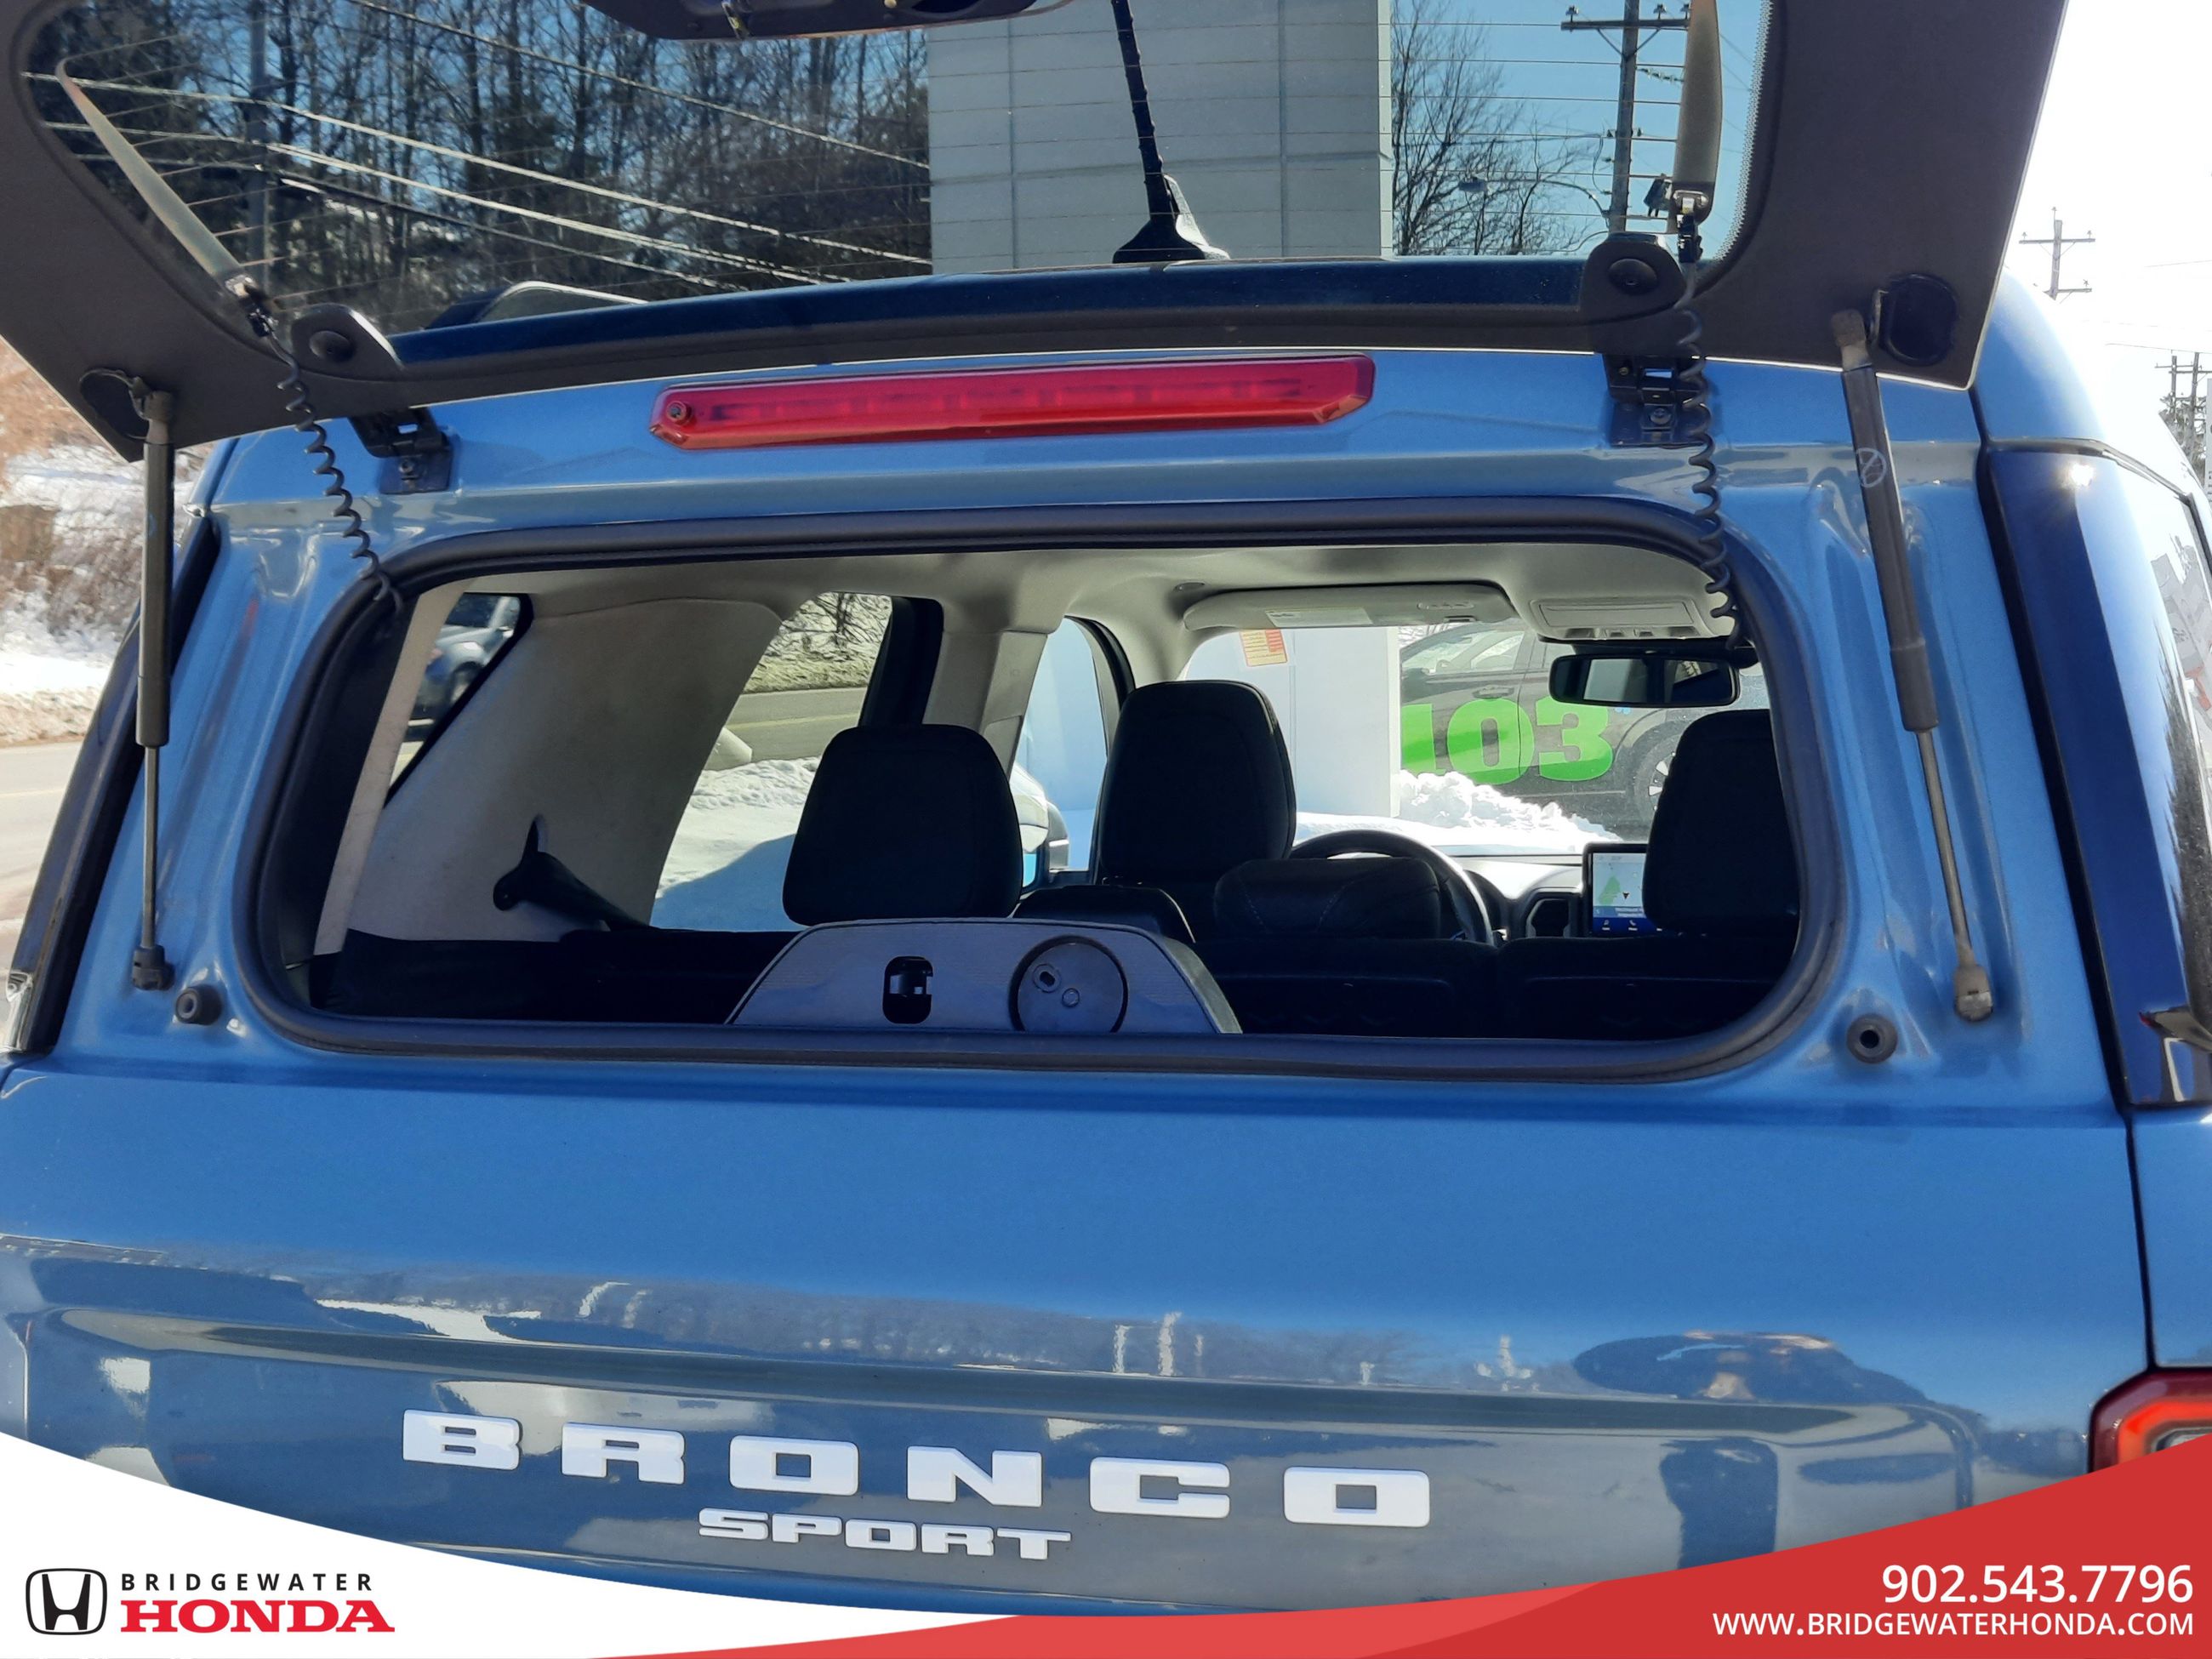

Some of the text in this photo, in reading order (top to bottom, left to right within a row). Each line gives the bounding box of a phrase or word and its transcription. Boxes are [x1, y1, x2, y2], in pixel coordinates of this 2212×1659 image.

[1400, 697, 1614, 784] 103
[402, 1409, 1430, 1527] BRONCO
[698, 1508, 1071, 1560] SPORT
